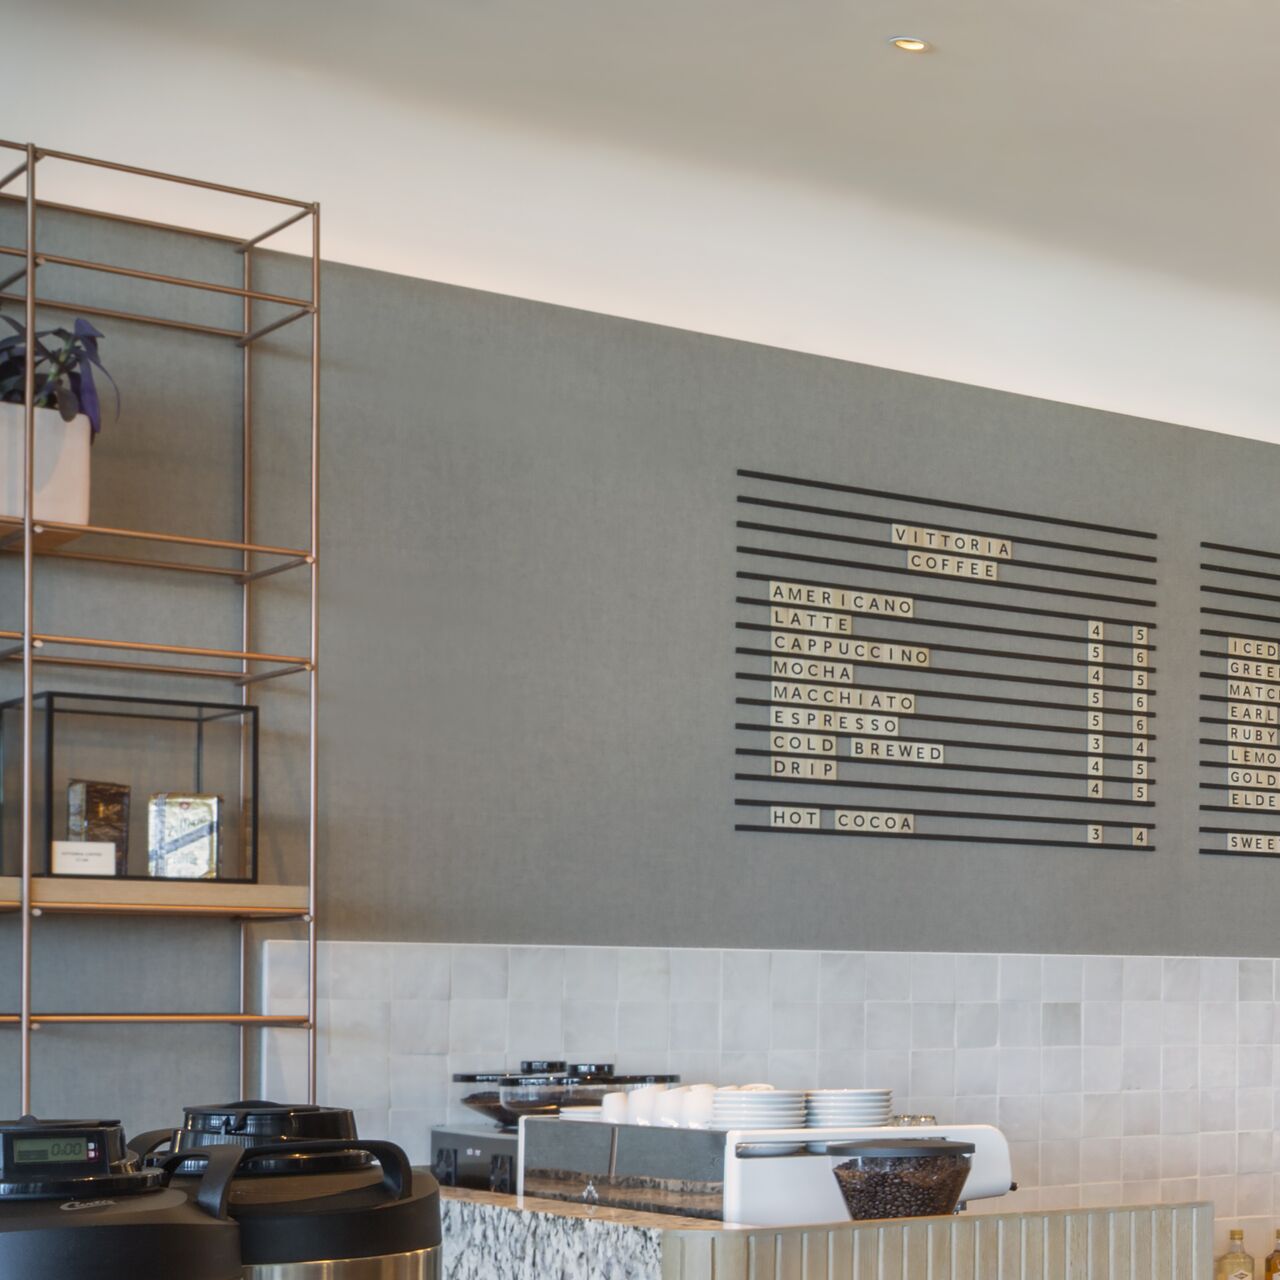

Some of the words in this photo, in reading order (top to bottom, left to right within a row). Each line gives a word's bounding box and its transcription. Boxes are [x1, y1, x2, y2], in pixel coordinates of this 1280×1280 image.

[895, 528, 1010, 556] VITTORIA
[910, 554, 995, 578] COFFEE
[772, 584, 912, 614] AMERICANO
[1092, 625, 1101, 637] 4
[1136, 628, 1144, 641] 5
[773, 612, 849, 632] LATTE
[1092, 646, 1101, 660] 5
[1136, 651, 1144, 664] 6
[1233, 640, 1277, 658] ICED
[773, 635, 928, 665] CAPPUCCINO
[1092, 669, 1101, 682] 4
[1136, 673, 1144, 687] 5
[772, 661, 851, 681] MOCHA
[1092, 691, 1101, 705] 5
[1136, 695, 1144, 709] 6
[773, 685, 913, 710] MACCHIATO
[1092, 714, 1101, 728] 5
[1136, 718, 1144, 732] 6
[1231, 706, 1275, 722] EARL
[774, 710, 896, 733] ESPRESSO
[1092, 737, 1101, 751] 3
[1136, 741, 1144, 754] 4
[1231, 728, 1276, 743] RUBY
[773, 735, 835, 753] COLD
[854, 742, 942, 761] BREWED
[1092, 760, 1101, 773] 4
[1136, 763, 1144, 776] 5
[773, 759, 834, 778] DRIP
[1092, 782, 1101, 796] 4
[1136, 785, 1144, 799] 5
[773, 810, 817, 826] HOT
[838, 813, 913, 831] COCOA
[1092, 827, 1101, 841] 3
[1136, 830, 1144, 843] 4
[51, 1142, 82, 1156] 0:00
